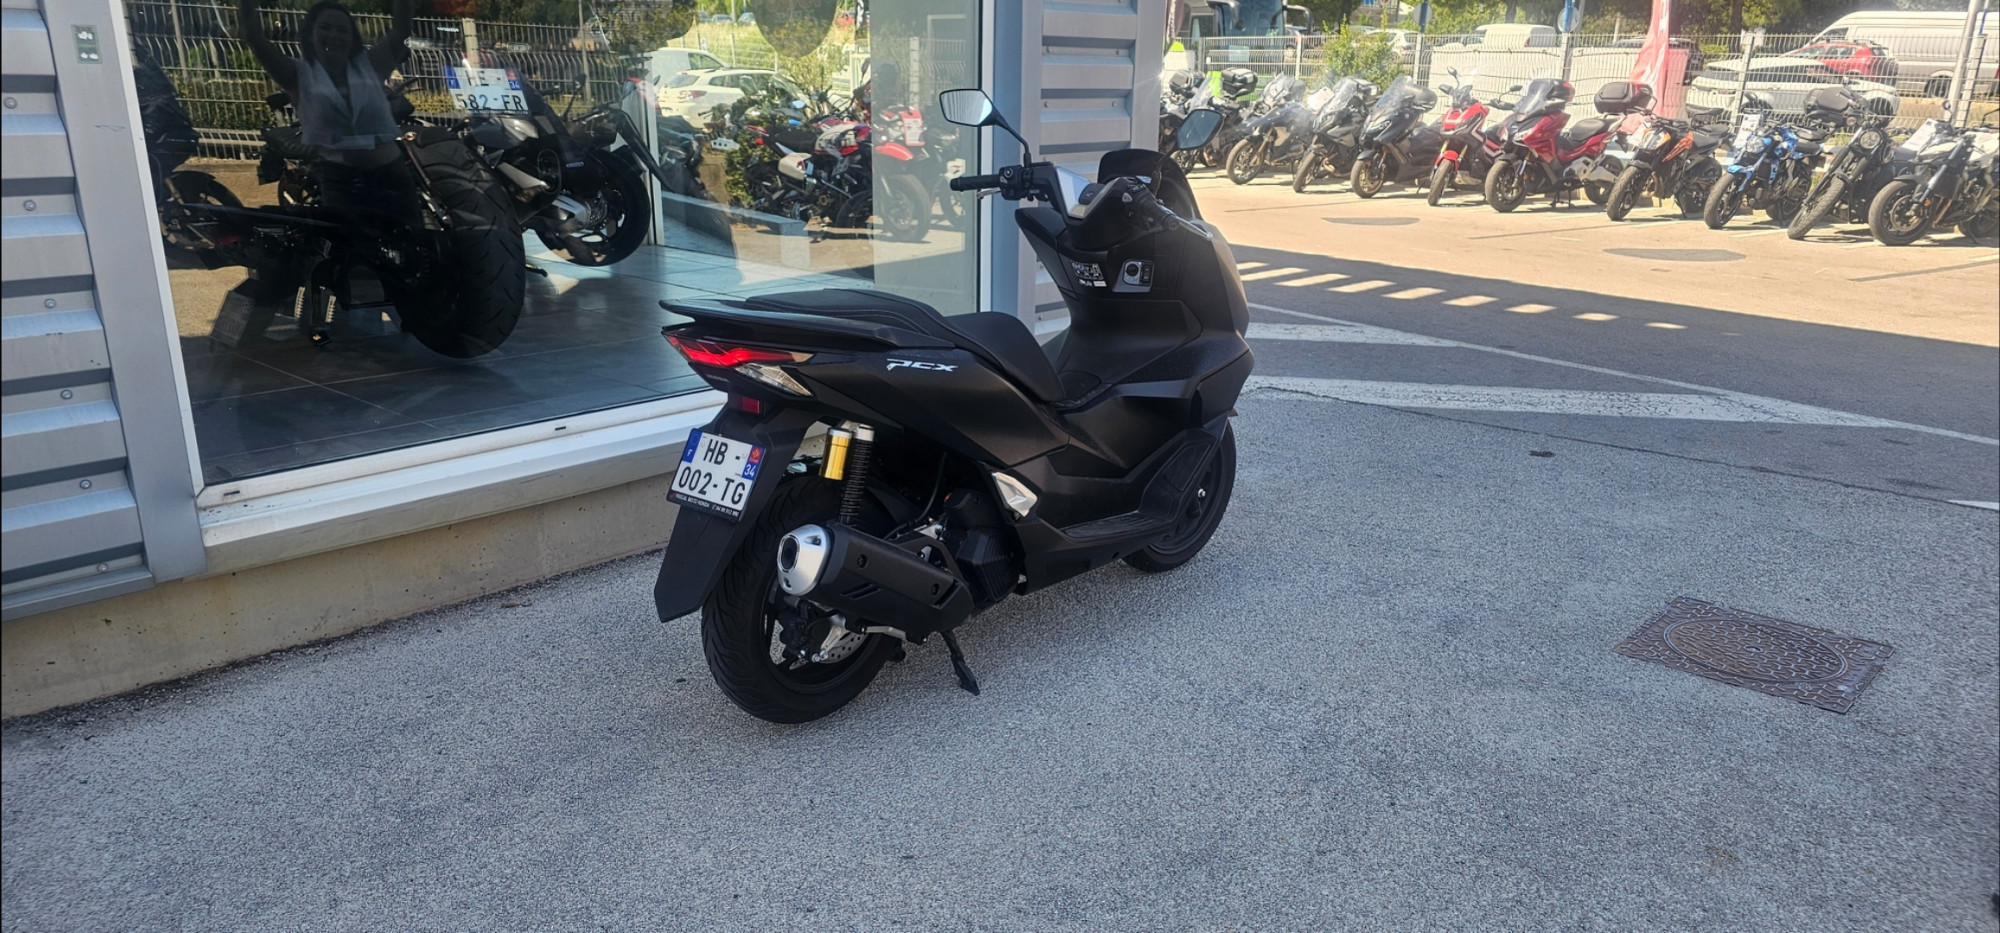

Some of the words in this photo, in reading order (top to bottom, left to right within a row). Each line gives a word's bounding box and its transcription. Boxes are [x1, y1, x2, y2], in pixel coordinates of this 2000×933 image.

[886, 358, 958, 372] PCX
[687, 449, 693, 457] F
[702, 438, 729, 465] HB
[744, 464, 757, 478] 34
